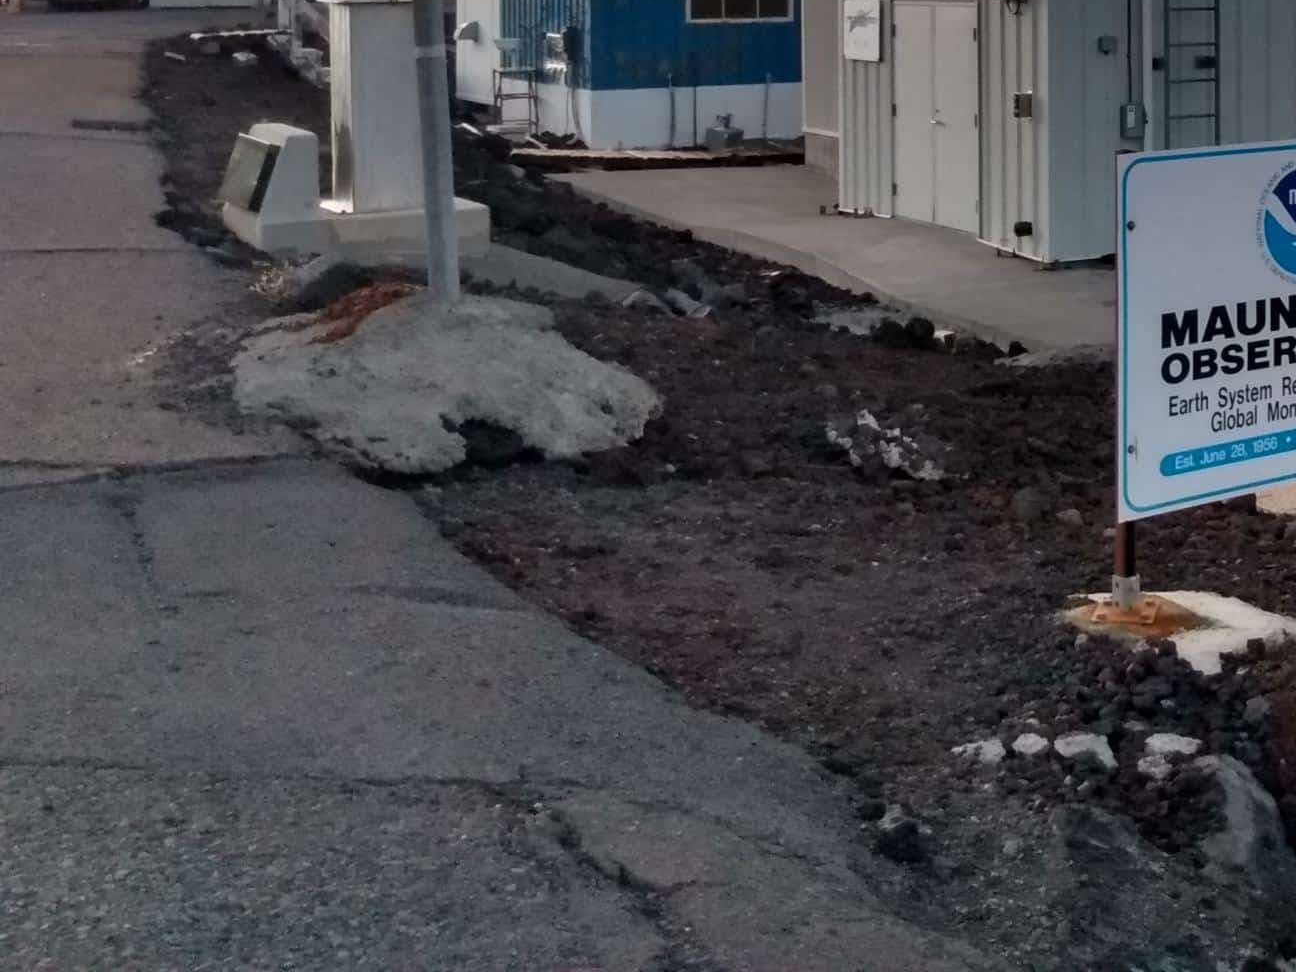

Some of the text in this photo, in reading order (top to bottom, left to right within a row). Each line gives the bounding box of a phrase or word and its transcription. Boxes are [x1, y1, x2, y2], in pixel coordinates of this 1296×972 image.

[1169, 391, 1208, 417] Earth
[1218, 384, 1272, 410] System
[1211, 405, 1257, 432] Global
[1200, 450, 1226, 465] June
[1230, 443, 1248, 458] 28,
[1253, 436, 1278, 453] 1956
